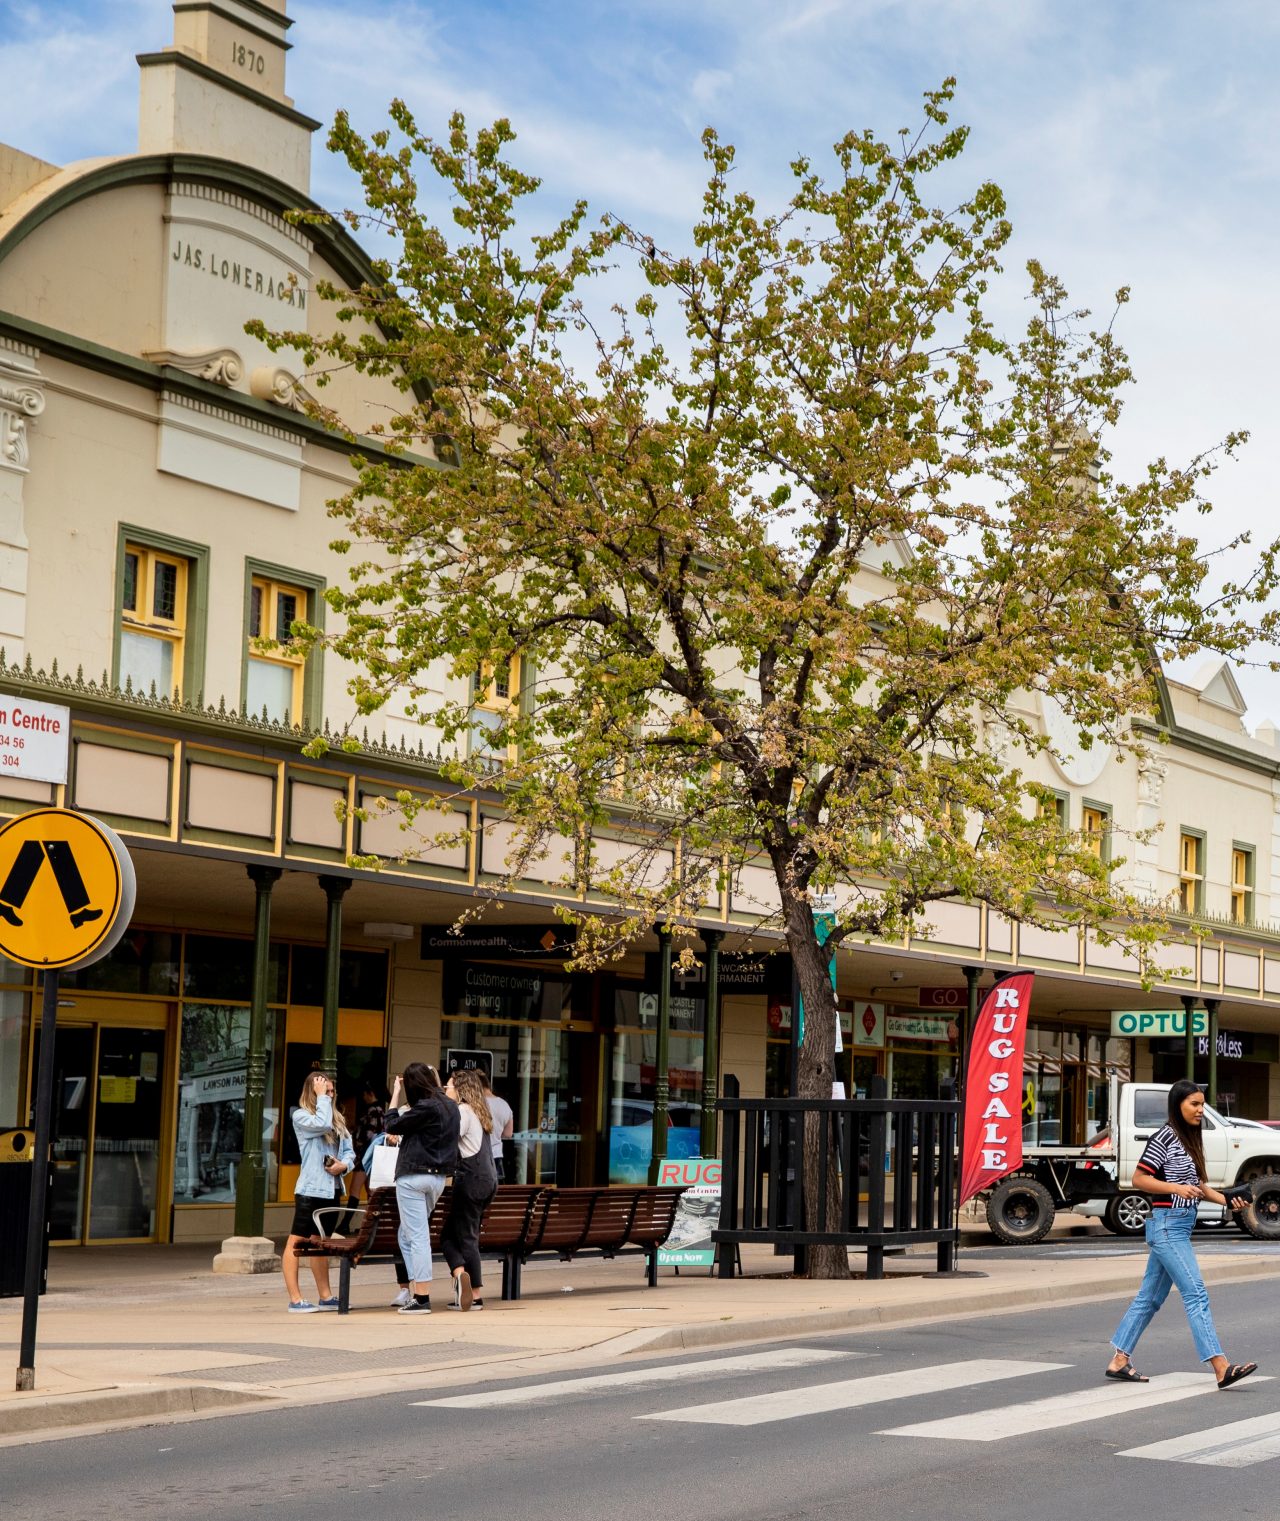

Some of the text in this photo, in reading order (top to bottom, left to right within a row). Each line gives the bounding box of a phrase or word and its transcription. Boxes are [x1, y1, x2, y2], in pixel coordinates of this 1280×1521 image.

[232, 41, 264, 74] 1870
[173, 241, 206, 271] JAS.
[12, 708, 60, 734] Centre
[13, 737, 25, 749] 56
[2, 754, 20, 768] 304
[429, 937, 507, 947] Commonwealth
[466, 968, 542, 992] Customer owned
[717, 974, 765, 983] ERMANENT
[465, 989, 500, 1012] banking
[932, 989, 958, 1004] GO
[1119, 1013, 1205, 1033] OPTUS
[464, 1059, 477, 1070] ATM
[203, 1075, 247, 1091] LAWSON PAR
[981, 988, 1020, 1171] RUG SALE
[660, 1252, 703, 1263] Open Now
